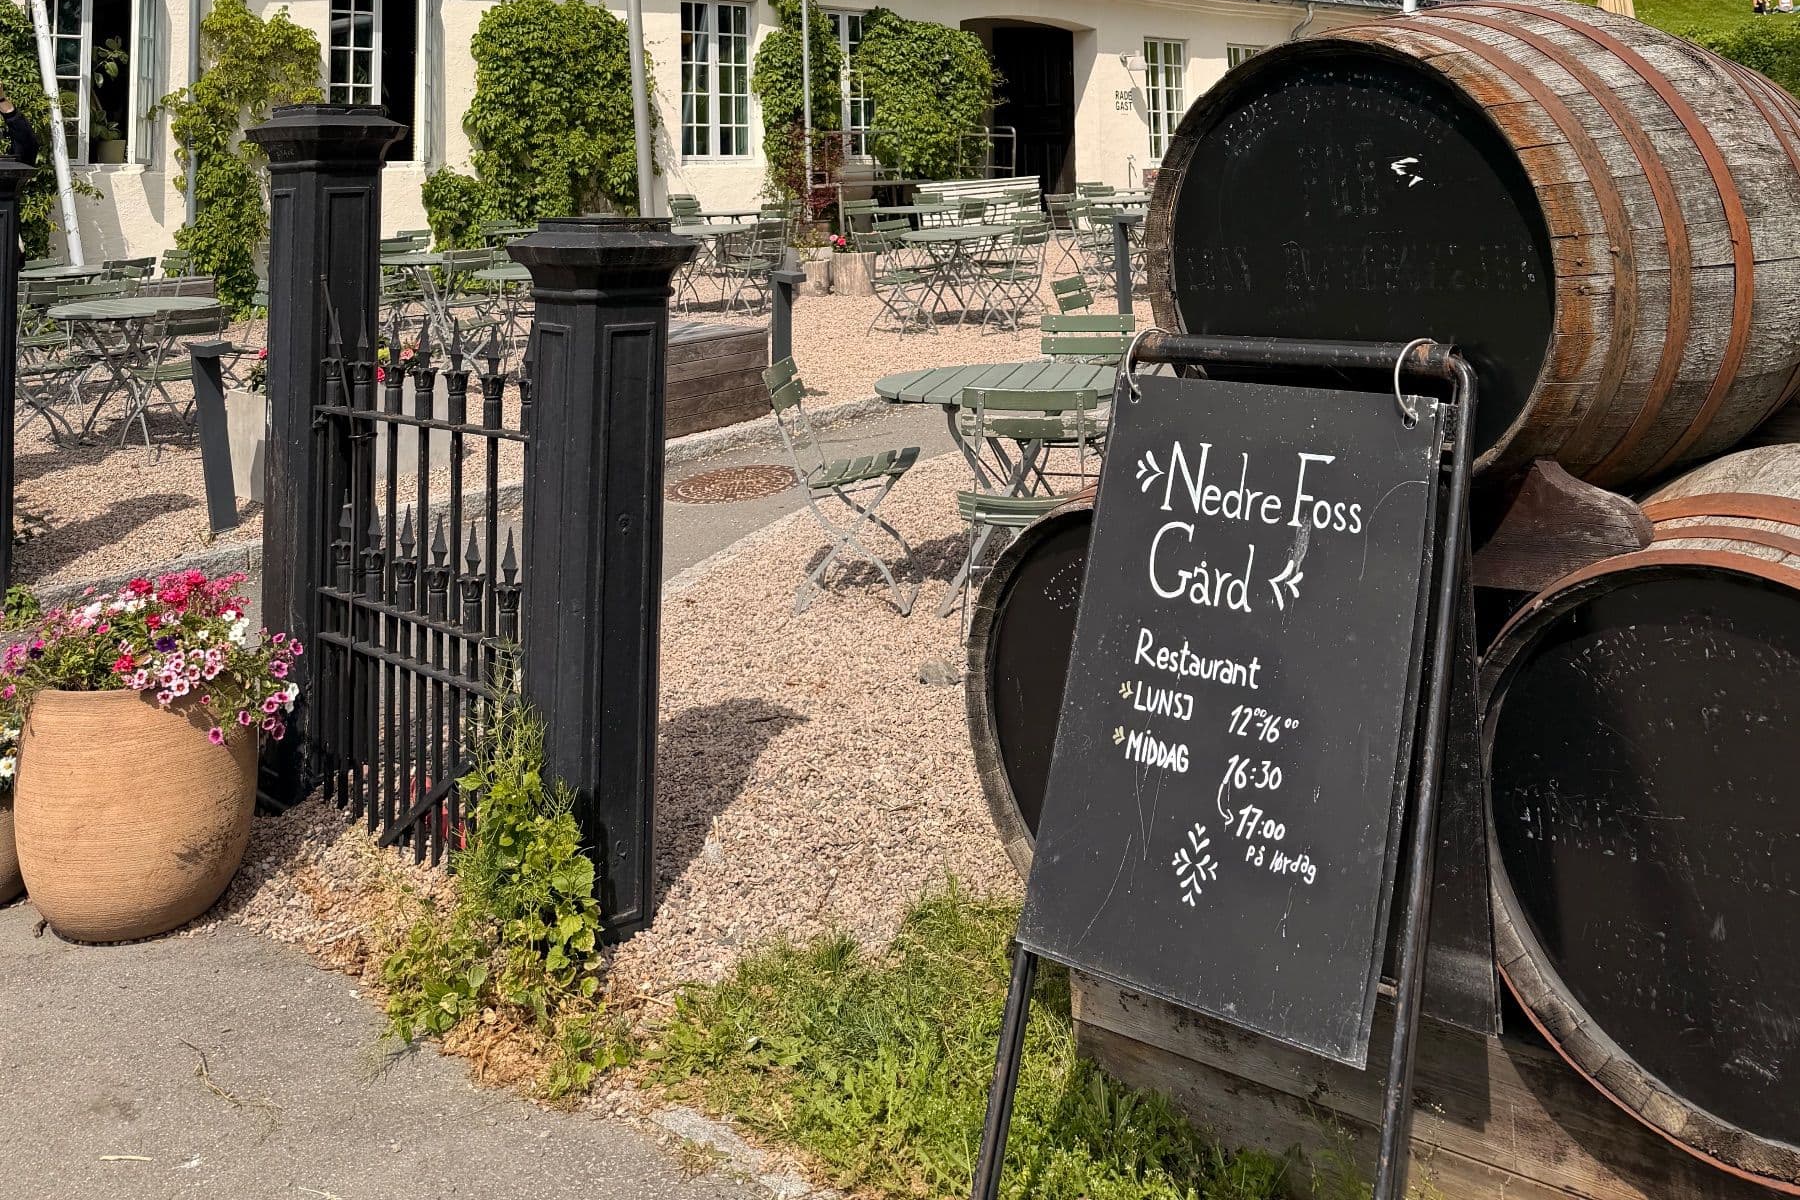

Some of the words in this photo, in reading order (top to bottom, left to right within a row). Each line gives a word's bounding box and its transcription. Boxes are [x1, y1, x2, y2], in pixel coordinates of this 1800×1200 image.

[1115, 90, 1133, 101] RADE
[1115, 101, 1133, 111] GAST
[1160, 440, 1282, 524] Nedre
[1287, 452, 1362, 534] Foss
[1149, 521, 1255, 613] Gård
[1135, 628, 1261, 689] Restaurant
[1133, 681, 1194, 721] LUNSJ
[1222, 754, 1282, 790] 16:30
[1236, 804, 1286, 841] 17:00
